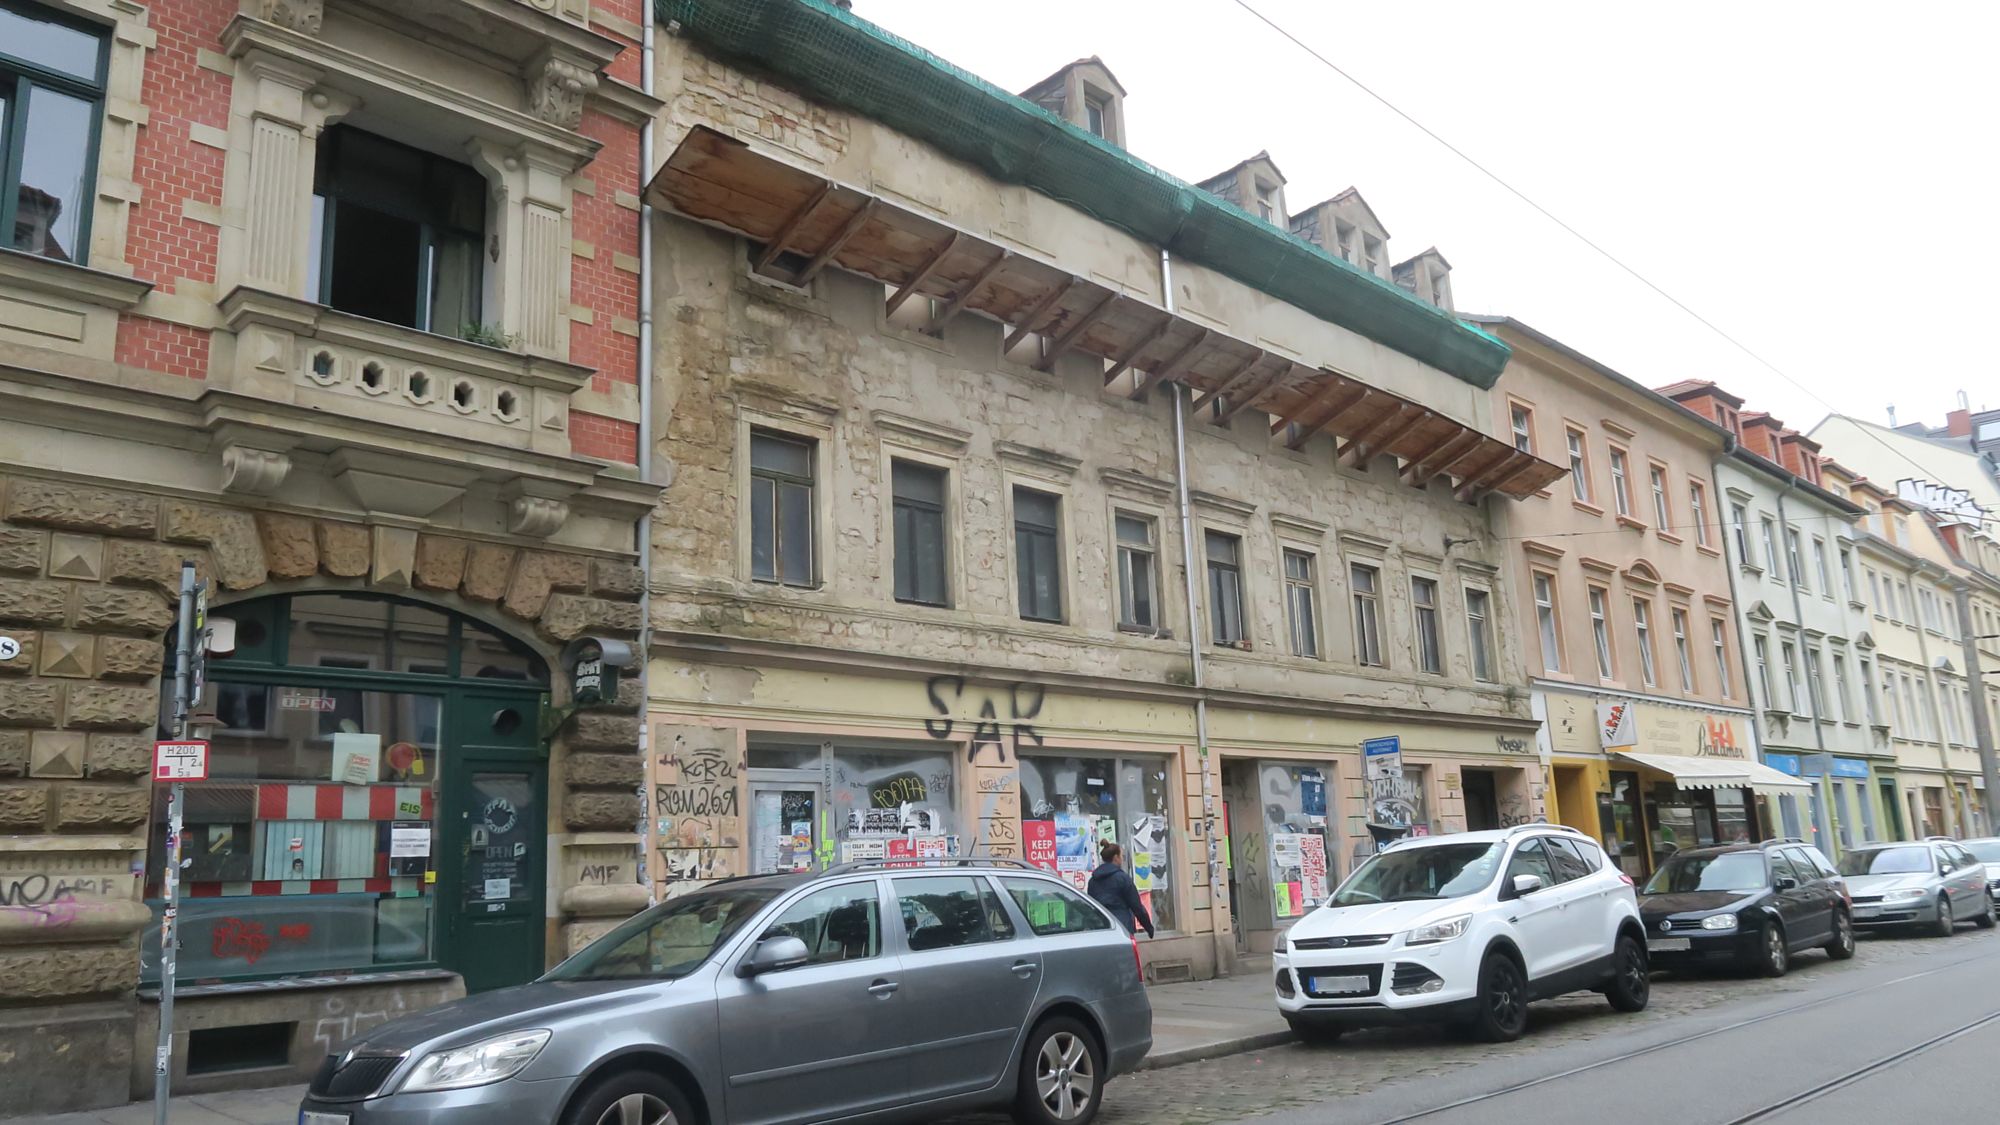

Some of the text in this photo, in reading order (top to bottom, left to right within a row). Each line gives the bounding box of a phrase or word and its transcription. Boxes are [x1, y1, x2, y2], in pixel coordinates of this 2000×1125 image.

[281, 697, 336, 711] OPEN
[400, 802, 421, 815] EIS
[1031, 839, 1053, 850] KEEP
[1030, 850, 1055, 860] CALM
